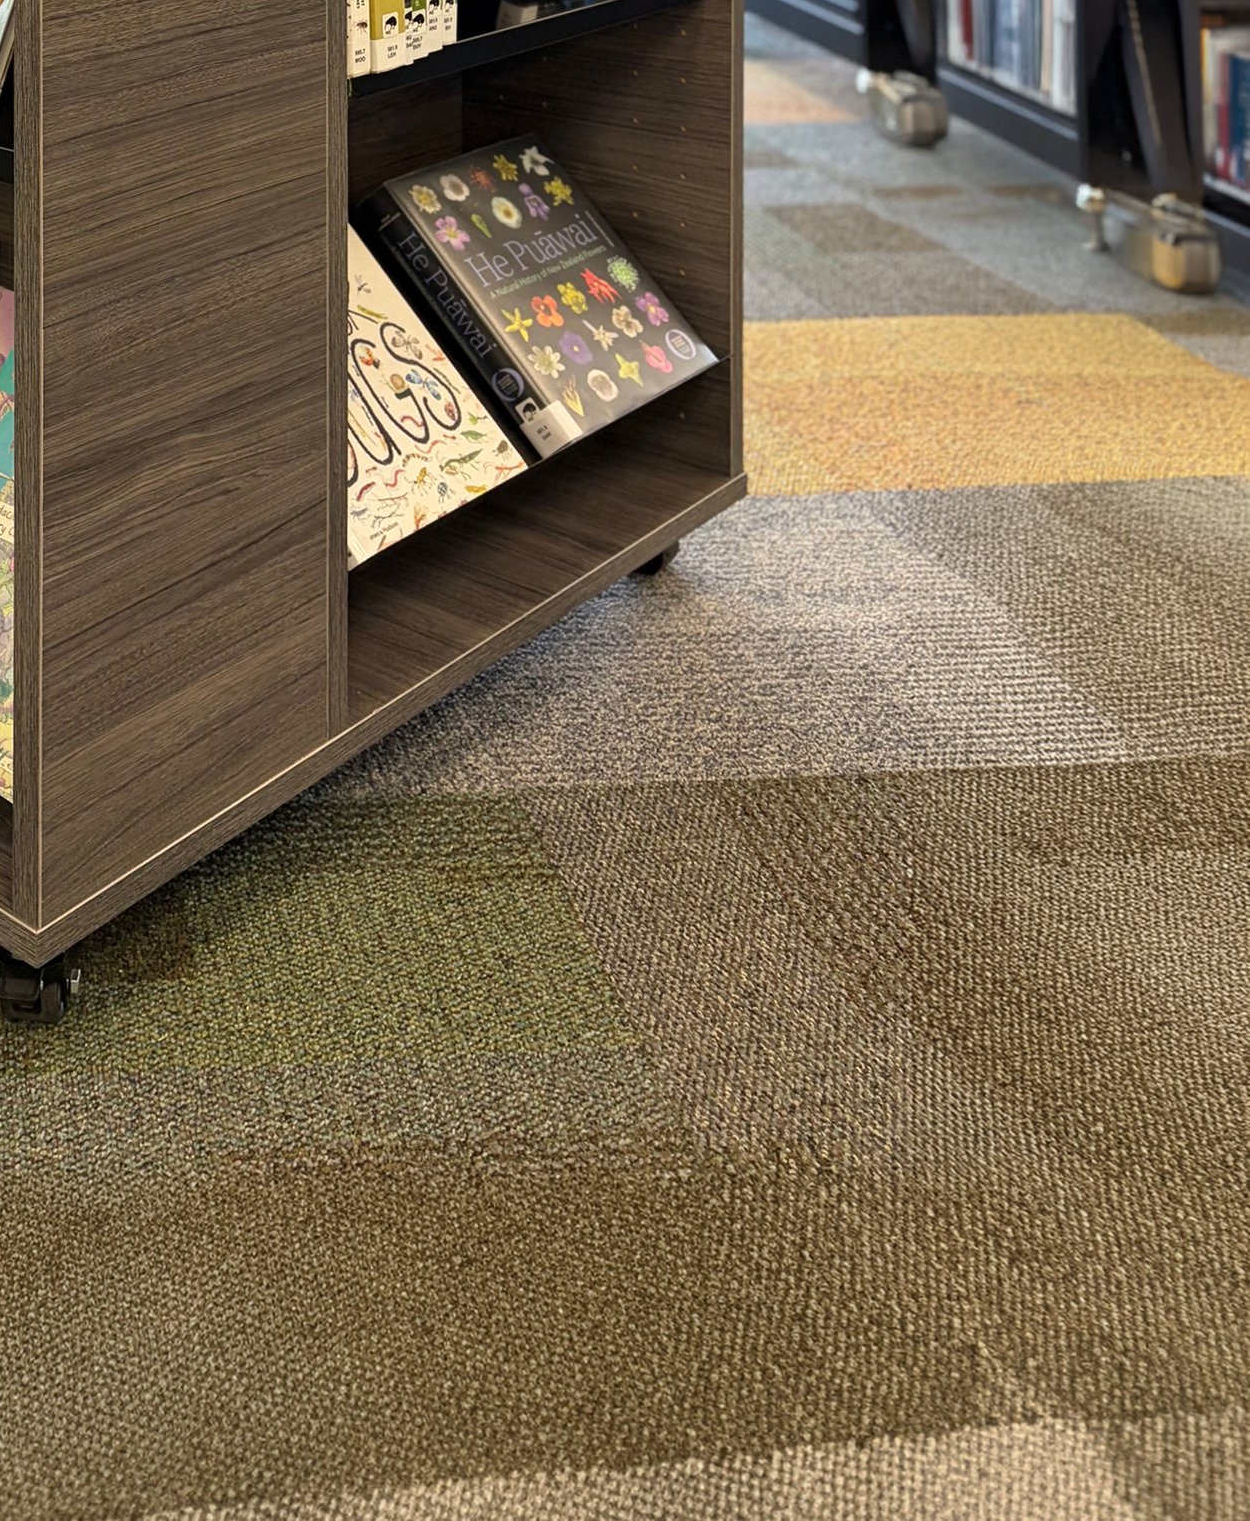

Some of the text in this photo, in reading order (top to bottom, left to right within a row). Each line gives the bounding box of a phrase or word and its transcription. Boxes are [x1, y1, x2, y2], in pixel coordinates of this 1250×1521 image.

[398, 231, 498, 360] He Puāwai
[463, 213, 599, 287] He Puāwai
[495, 278, 520, 296] Natural
[518, 271, 543, 290] History
[545, 262, 562, 276] New
[558, 253, 587, 271] Zealand
[347, 322, 462, 487] UGS
